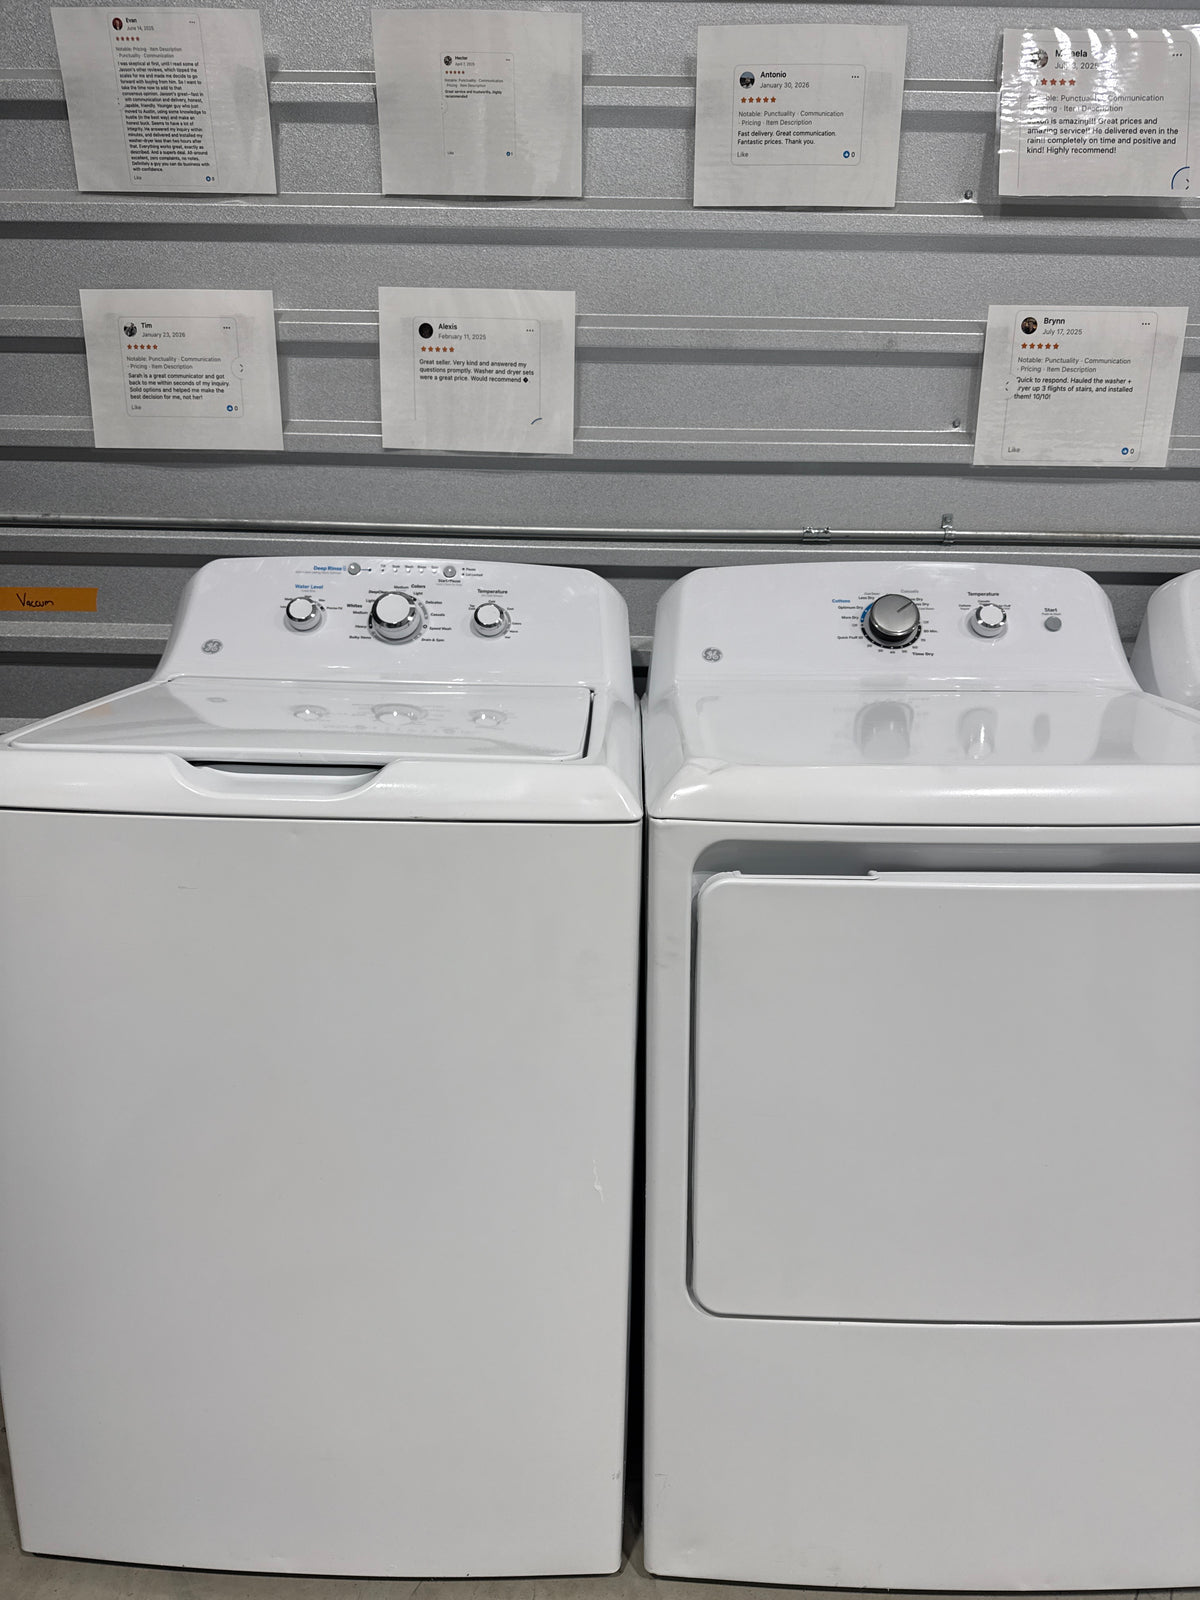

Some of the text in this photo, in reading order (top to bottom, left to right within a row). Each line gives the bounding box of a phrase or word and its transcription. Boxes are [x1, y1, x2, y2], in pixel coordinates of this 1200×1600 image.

[760, 82, 782, 90] January
[1120, 118, 1142, 126] prices
[1047, 137, 1087, 145] completely
[1133, 137, 1161, 145] positive
[1047, 147, 1069, 155] Highly
[1044, 318, 1065, 326] Brynn
[1045, 357, 1079, 365] Punctuality
